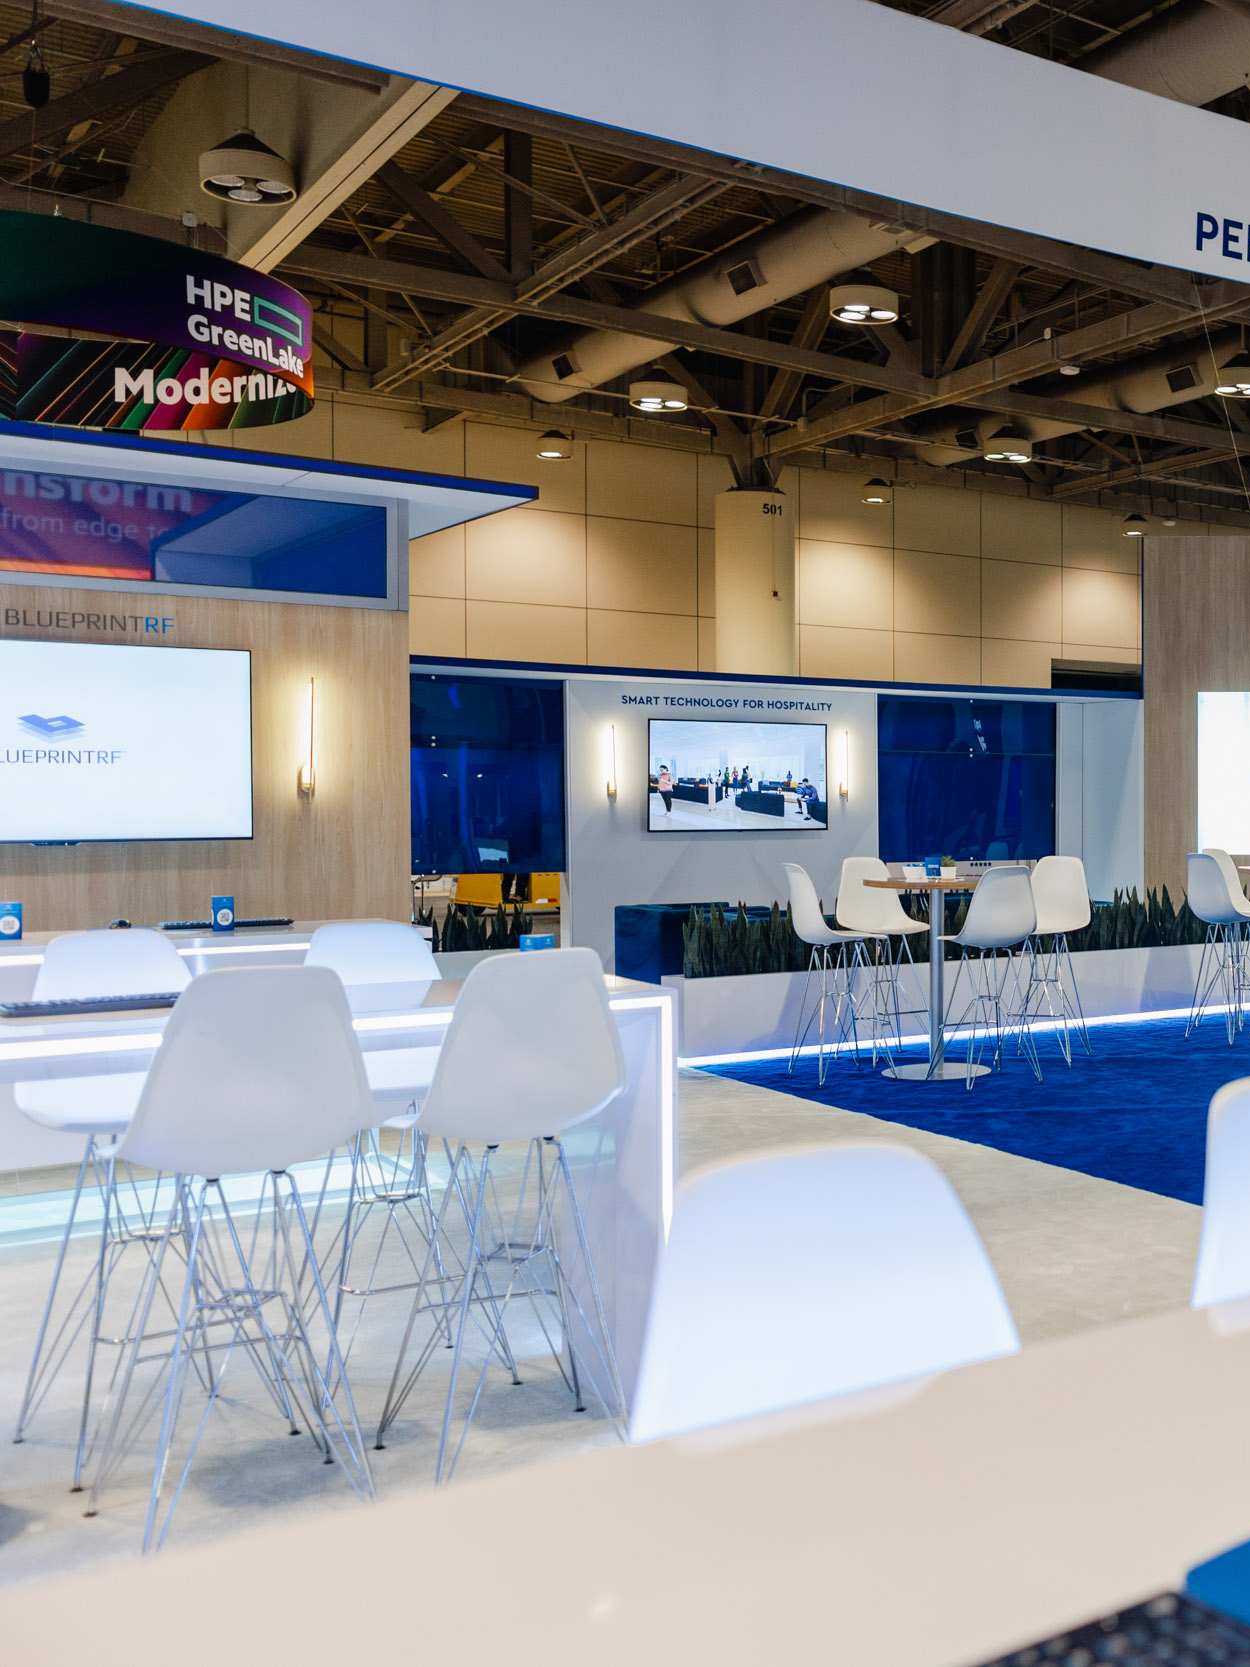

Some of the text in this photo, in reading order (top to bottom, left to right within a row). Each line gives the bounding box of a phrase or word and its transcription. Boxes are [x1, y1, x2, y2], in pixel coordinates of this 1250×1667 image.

[186, 274, 251, 322] HPE
[187, 314, 304, 377] GreenLake
[1, 507, 64, 533] from
[74, 516, 138, 542] edge
[762, 503, 783, 516] 501
[4, 608, 175, 634] BLUEPRINTRF
[621, 695, 832, 712] SMART TECHNOLOGY FOR HOSPITALITY
